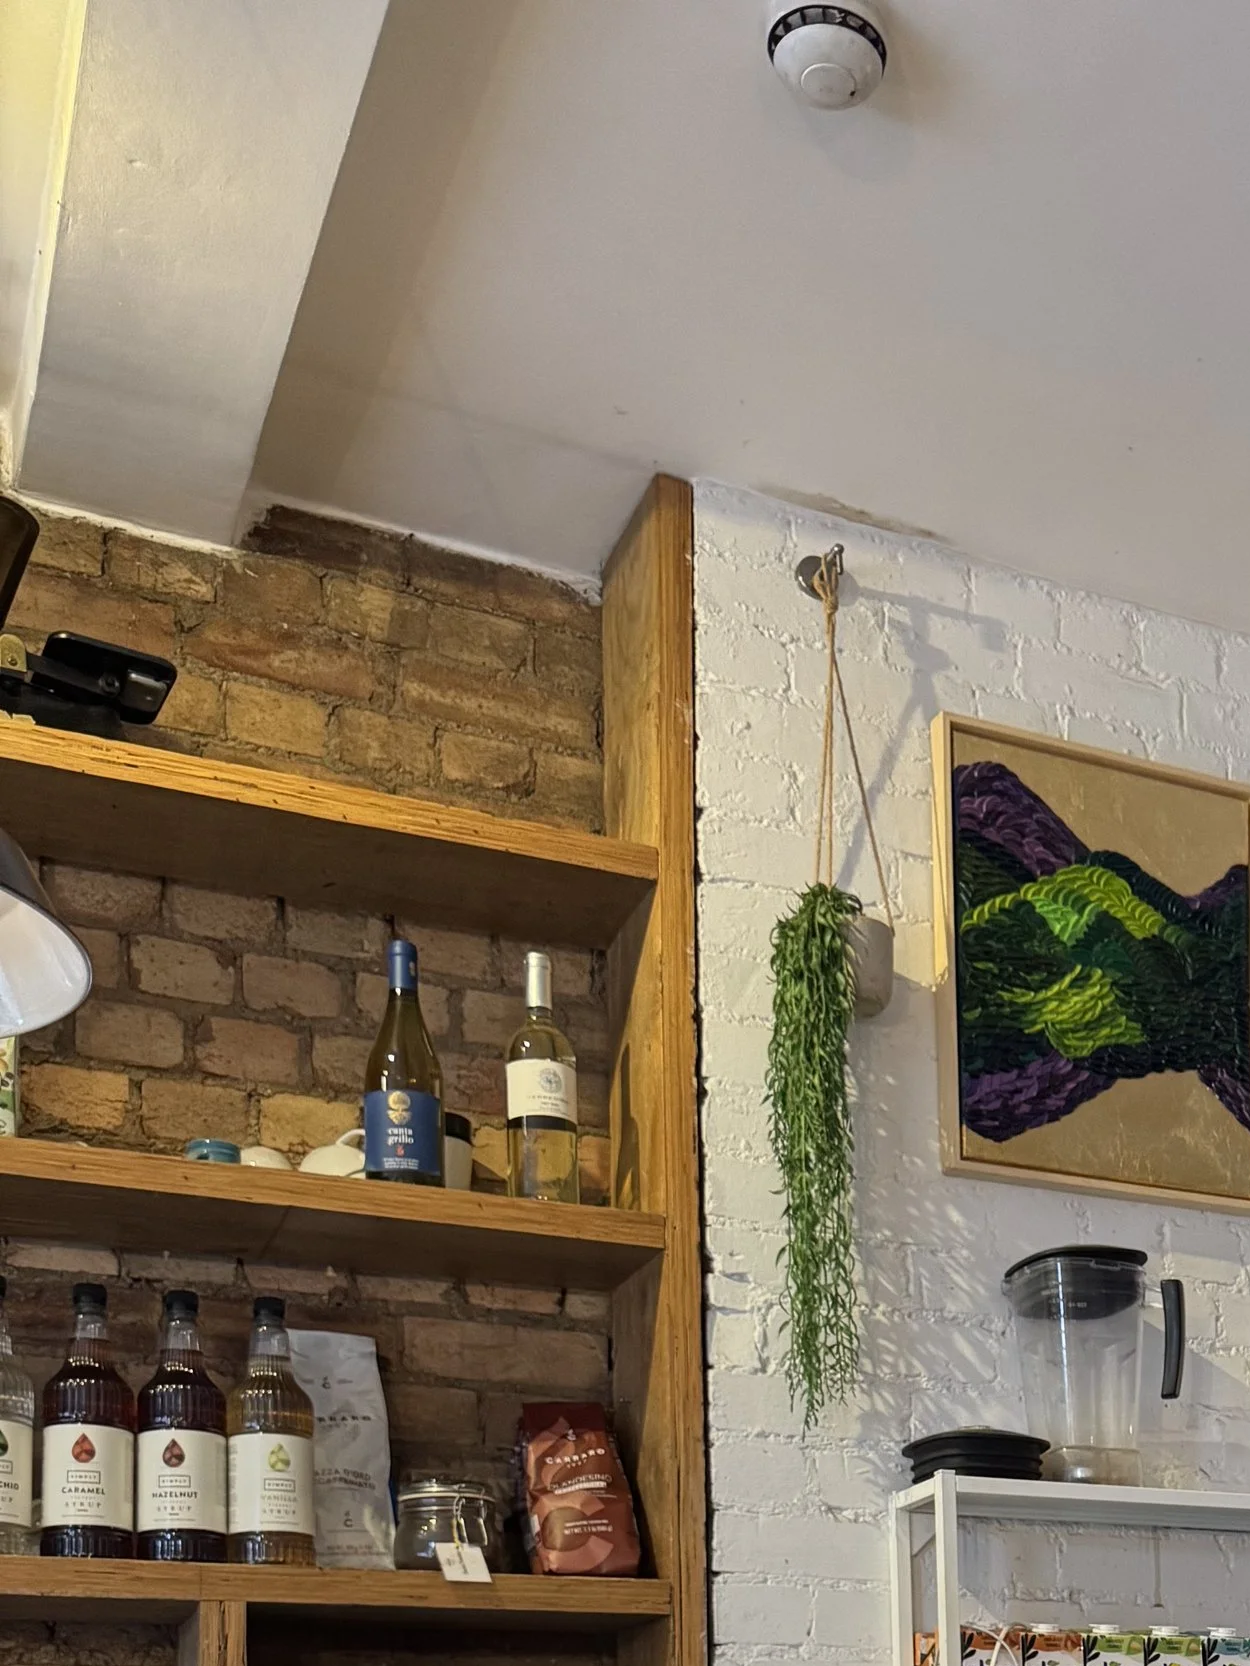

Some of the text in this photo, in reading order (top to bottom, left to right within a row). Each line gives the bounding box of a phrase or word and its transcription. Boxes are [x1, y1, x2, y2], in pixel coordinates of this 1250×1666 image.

[544, 1447, 607, 1465] CARRARO
[61, 1485, 107, 1497] CARAMEL
[151, 1490, 199, 1500] HAZELNUT
[261, 1494, 299, 1503] VANILLA
[64, 1501, 103, 1510] SYRUP
